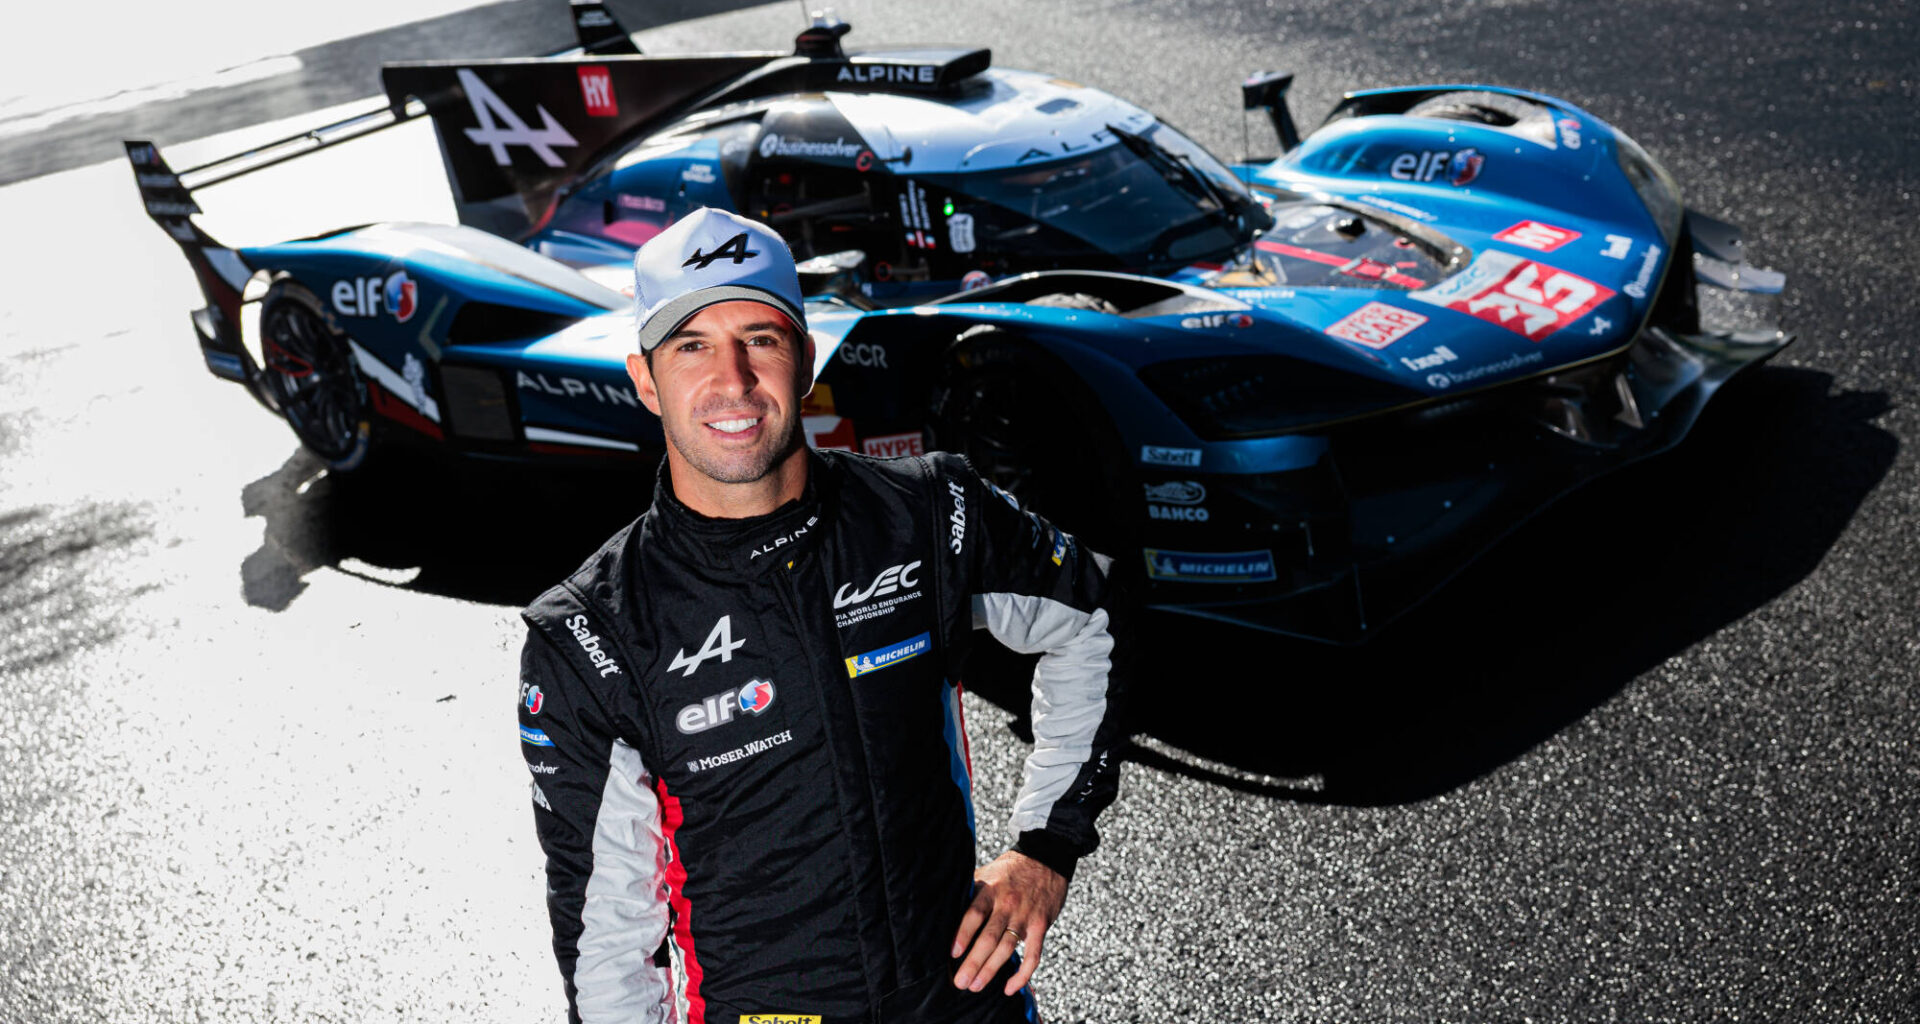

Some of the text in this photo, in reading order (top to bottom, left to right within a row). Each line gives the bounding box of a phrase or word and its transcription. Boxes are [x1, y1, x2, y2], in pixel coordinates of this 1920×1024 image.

[837, 66, 935, 83] ALPINE
[582, 76, 611, 108] HY
[776, 136, 863, 157] businessolver
[1391, 151, 1450, 182] elf
[1504, 222, 1566, 249] HY
[332, 277, 383, 317] elf
[1468, 263, 1597, 336] 35
[1181, 315, 1224, 329] elf
[1354, 312, 1420, 344] CAR
[840, 342, 888, 369] GCR
[517, 370, 639, 408] ALPIN
[1150, 451, 1194, 464] Sabelt
[949, 481, 966, 555] Sabelt
[1149, 505, 1209, 522] BAHCO
[750, 516, 818, 560] ALPINE
[1179, 562, 1269, 575] MICHELIN
[833, 560, 921, 610] WEC
[835, 590, 922, 621] FIA WORLD ENDURANCE
[837, 606, 896, 628] CHAMPIONSHIP
[565, 614, 622, 678] Sabelt
[875, 640, 925, 664] MICHELIN
[679, 692, 736, 731] elf
[699, 729, 793, 770] MOSER.WATCH
